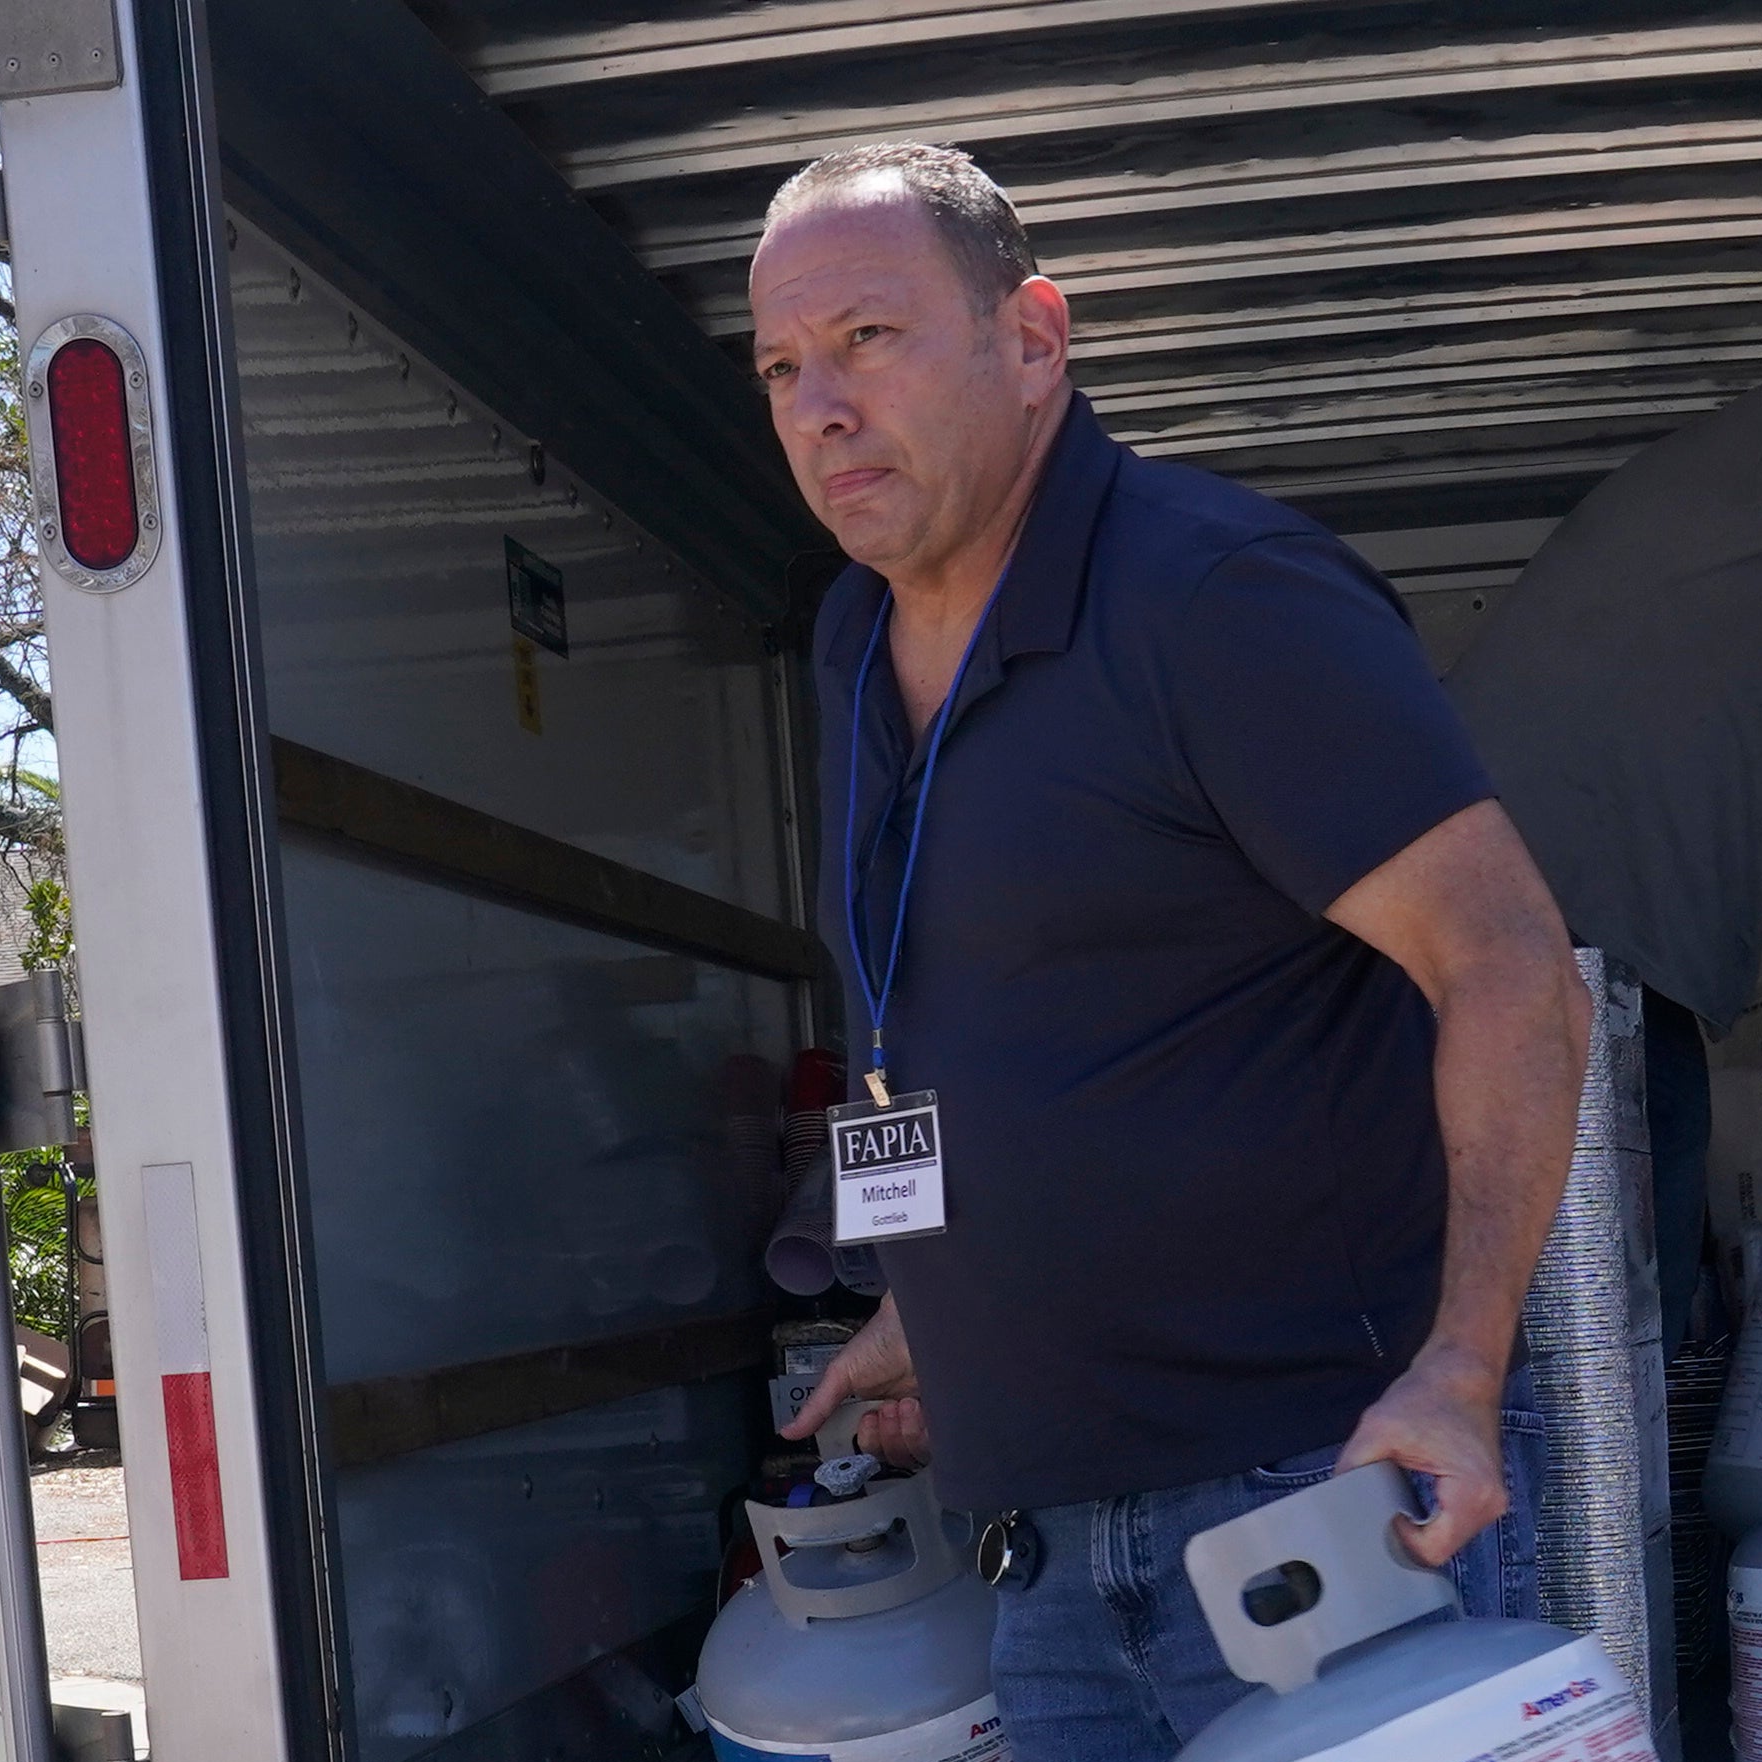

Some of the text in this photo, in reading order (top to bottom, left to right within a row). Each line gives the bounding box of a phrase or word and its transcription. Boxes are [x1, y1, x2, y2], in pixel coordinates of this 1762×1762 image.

[844, 1121, 930, 1165] FAPIA
[861, 1179, 917, 1204] Mitchell
[872, 1211, 908, 1228] Gottlieb
